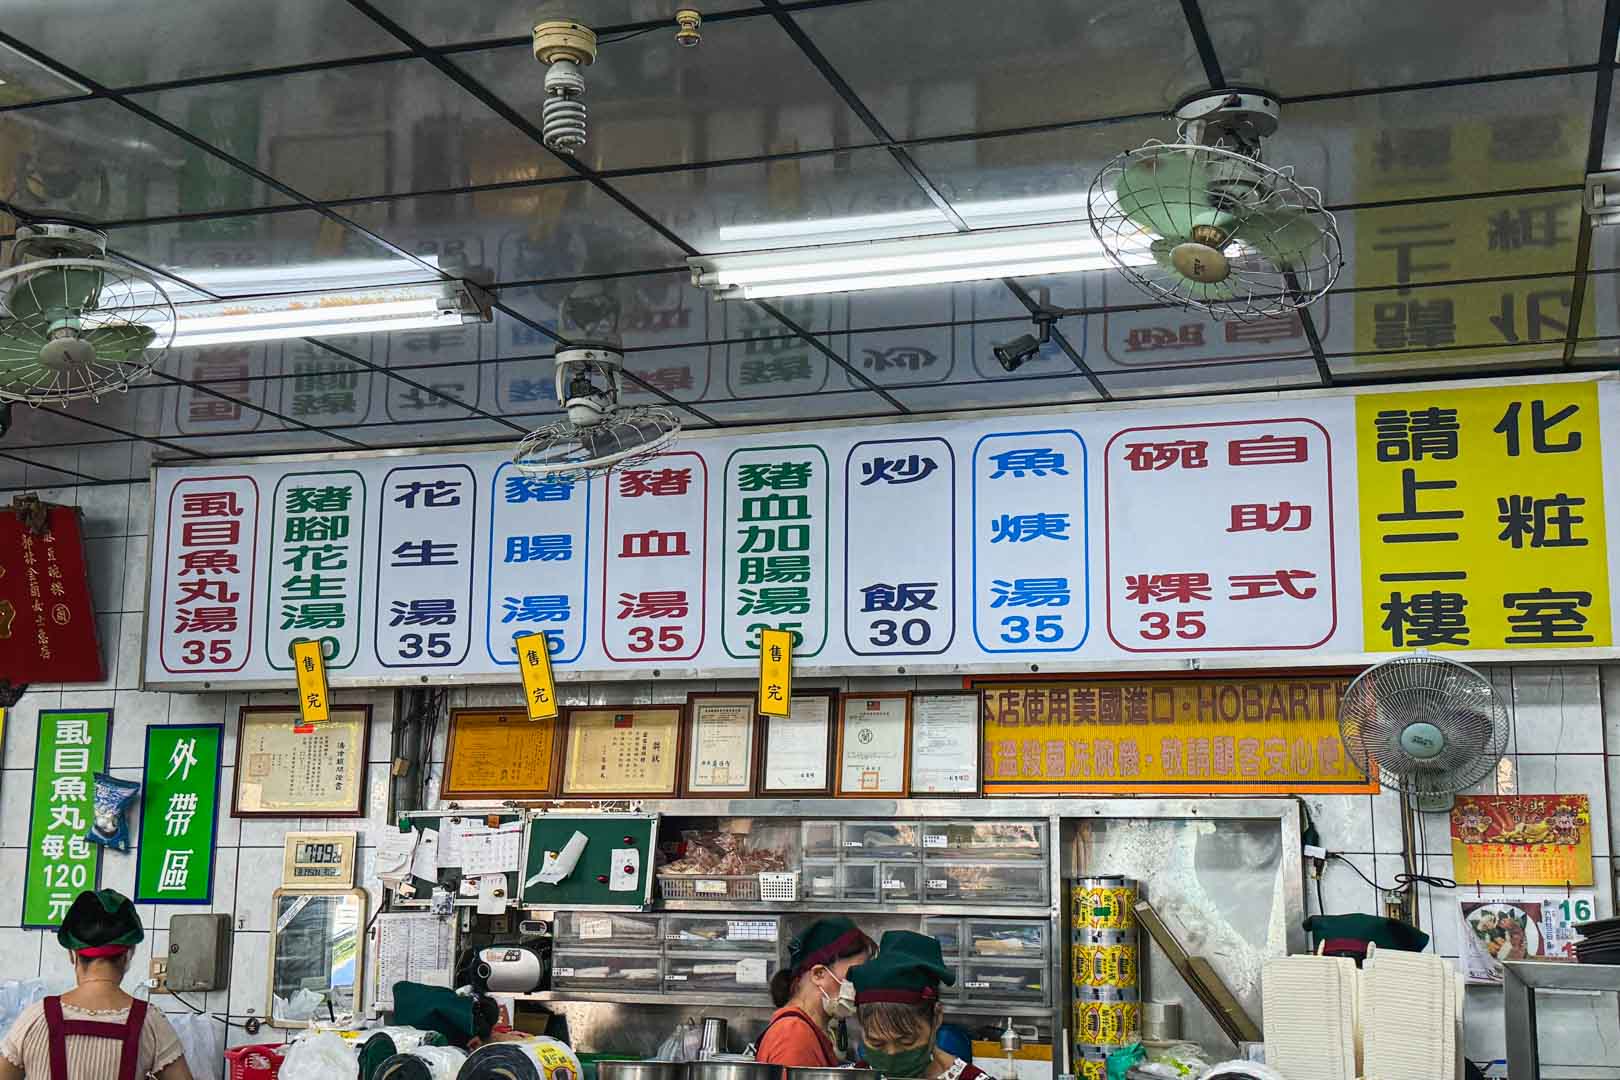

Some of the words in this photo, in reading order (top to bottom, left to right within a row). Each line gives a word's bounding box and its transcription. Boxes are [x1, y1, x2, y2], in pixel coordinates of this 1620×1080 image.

[173, 491, 243, 633] 虱目魚丸湯
[281, 485, 352, 630] 豬腳花生湯
[389, 481, 461, 627] 花生湯
[501, 473, 574, 624] 豬腸湯
[616, 467, 692, 620] 豬血湯
[736, 461, 813, 616] 豬血加腸湯
[859, 454, 939, 613] 炒飯
[1124, 439, 1212, 605] 碗粿
[1226, 435, 1317, 601] 自助式
[1375, 407, 1470, 647] 請上二樓
[1494, 400, 1594, 644] 化粧室
[182, 640, 232, 665] 35
[398, 633, 452, 658] 35
[527, 650, 549, 704] 售完
[628, 625, 684, 652] 35
[768, 644, 783, 701] 售完
[869, 618, 931, 647] 30
[1000, 614, 1064, 644] 35
[1139, 611, 1206, 641] 35
[303, 656, 322, 709] 售完
[48, 719, 92, 831] 虱目魚丸
[158, 738, 198, 893] 外帶區
[41, 834, 90, 860] 每包
[44, 864, 87, 888] 120
[1559, 899, 1591, 921] 16
